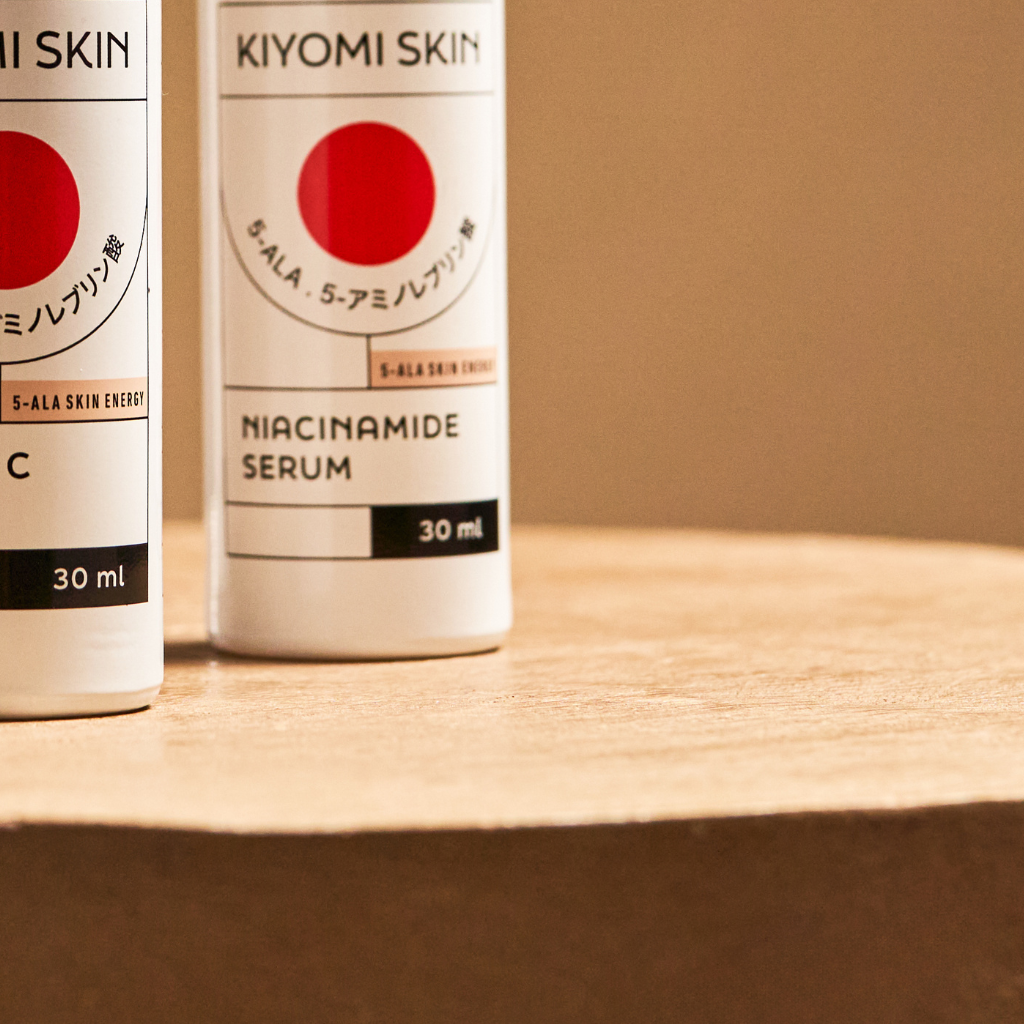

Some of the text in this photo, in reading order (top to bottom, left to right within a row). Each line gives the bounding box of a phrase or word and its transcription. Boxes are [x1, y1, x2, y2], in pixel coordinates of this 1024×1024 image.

[36, 30, 129, 69] SKIN
[237, 31, 480, 68] KIYOMI SKIN
[246, 218, 302, 289] 5-ALA
[13, 391, 144, 410] 5-ALA SKIN ENERGY
[241, 413, 459, 441] NIACINAMIDE
[7, 452, 30, 479] C
[242, 454, 352, 481] SERUM
[418, 517, 484, 542] 30 ml
[53, 565, 125, 590] 30 ml
